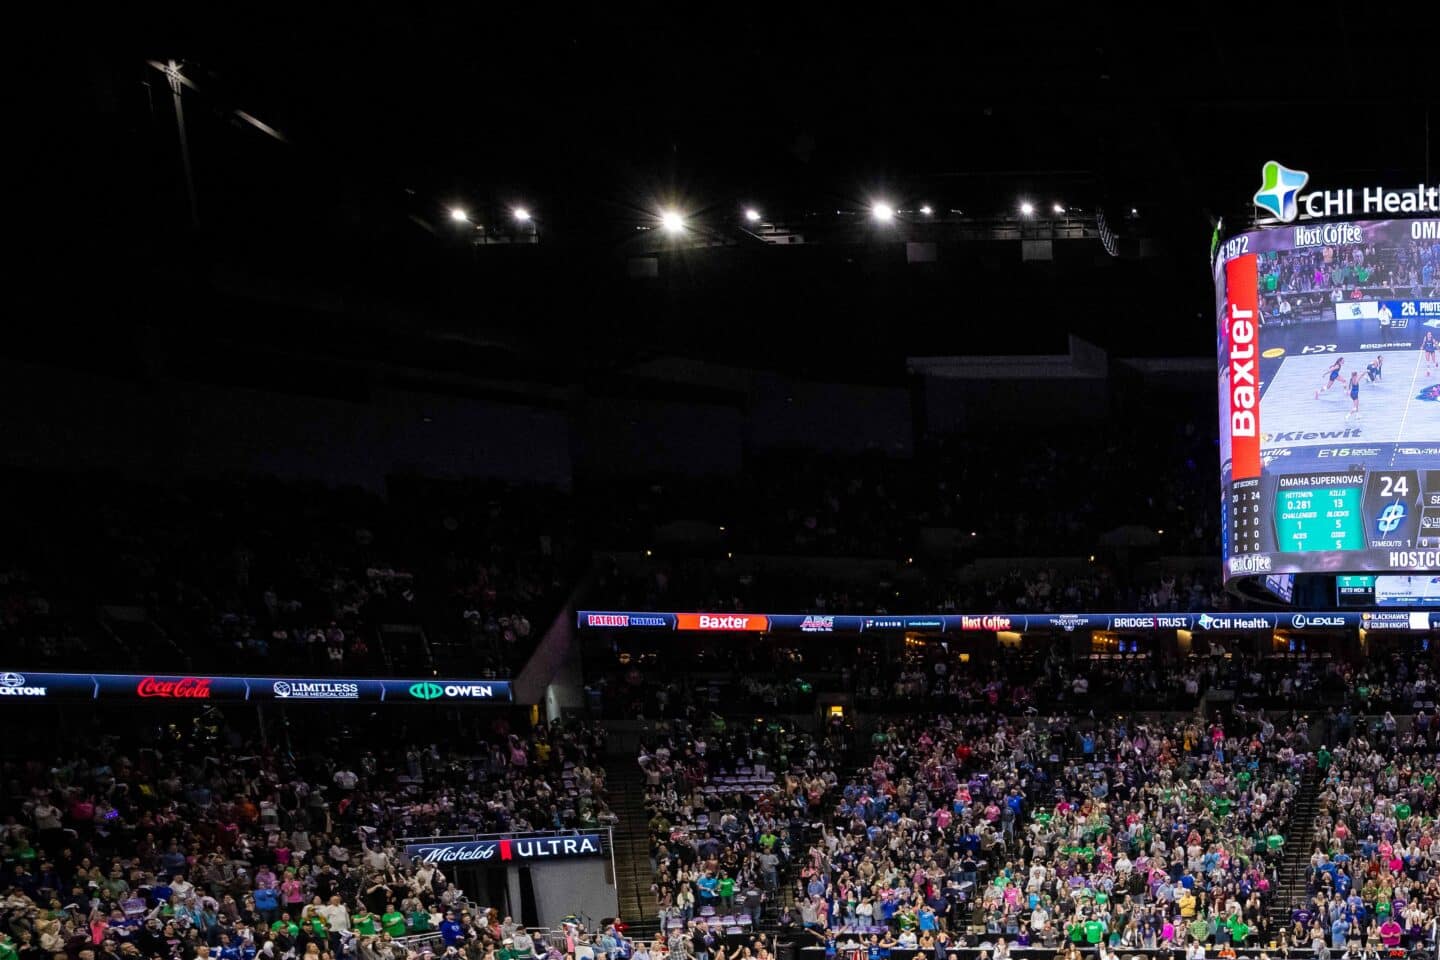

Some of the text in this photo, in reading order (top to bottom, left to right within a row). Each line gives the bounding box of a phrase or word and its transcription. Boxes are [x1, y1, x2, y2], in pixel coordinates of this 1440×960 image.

[1305, 189, 1353, 218] CHI
[1295, 223, 1362, 248] Host Coffee
[1225, 236, 1249, 259] 1972
[1230, 303, 1256, 438] Baxter
[1274, 428, 1363, 442] Kiewit
[1280, 475, 1364, 487] OMAHA SUPERNOVAS
[1380, 476, 1409, 497] 24
[1251, 491, 1260, 500] 24
[1287, 499, 1343, 510] 0.281 13
[588, 614, 630, 627] PATRIOT
[699, 615, 748, 629] Baxter
[962, 615, 1011, 630] Host Coffee
[1114, 617, 1186, 628] BRIDGES TRUST
[1213, 618, 1231, 628] CHI
[1306, 617, 1345, 626] LEXUS
[138, 676, 213, 698] Coca-Cola
[291, 683, 358, 693] LIMITLESS
[445, 686, 492, 697] OWEN
[412, 838, 595, 863] Michelob ULTRA
